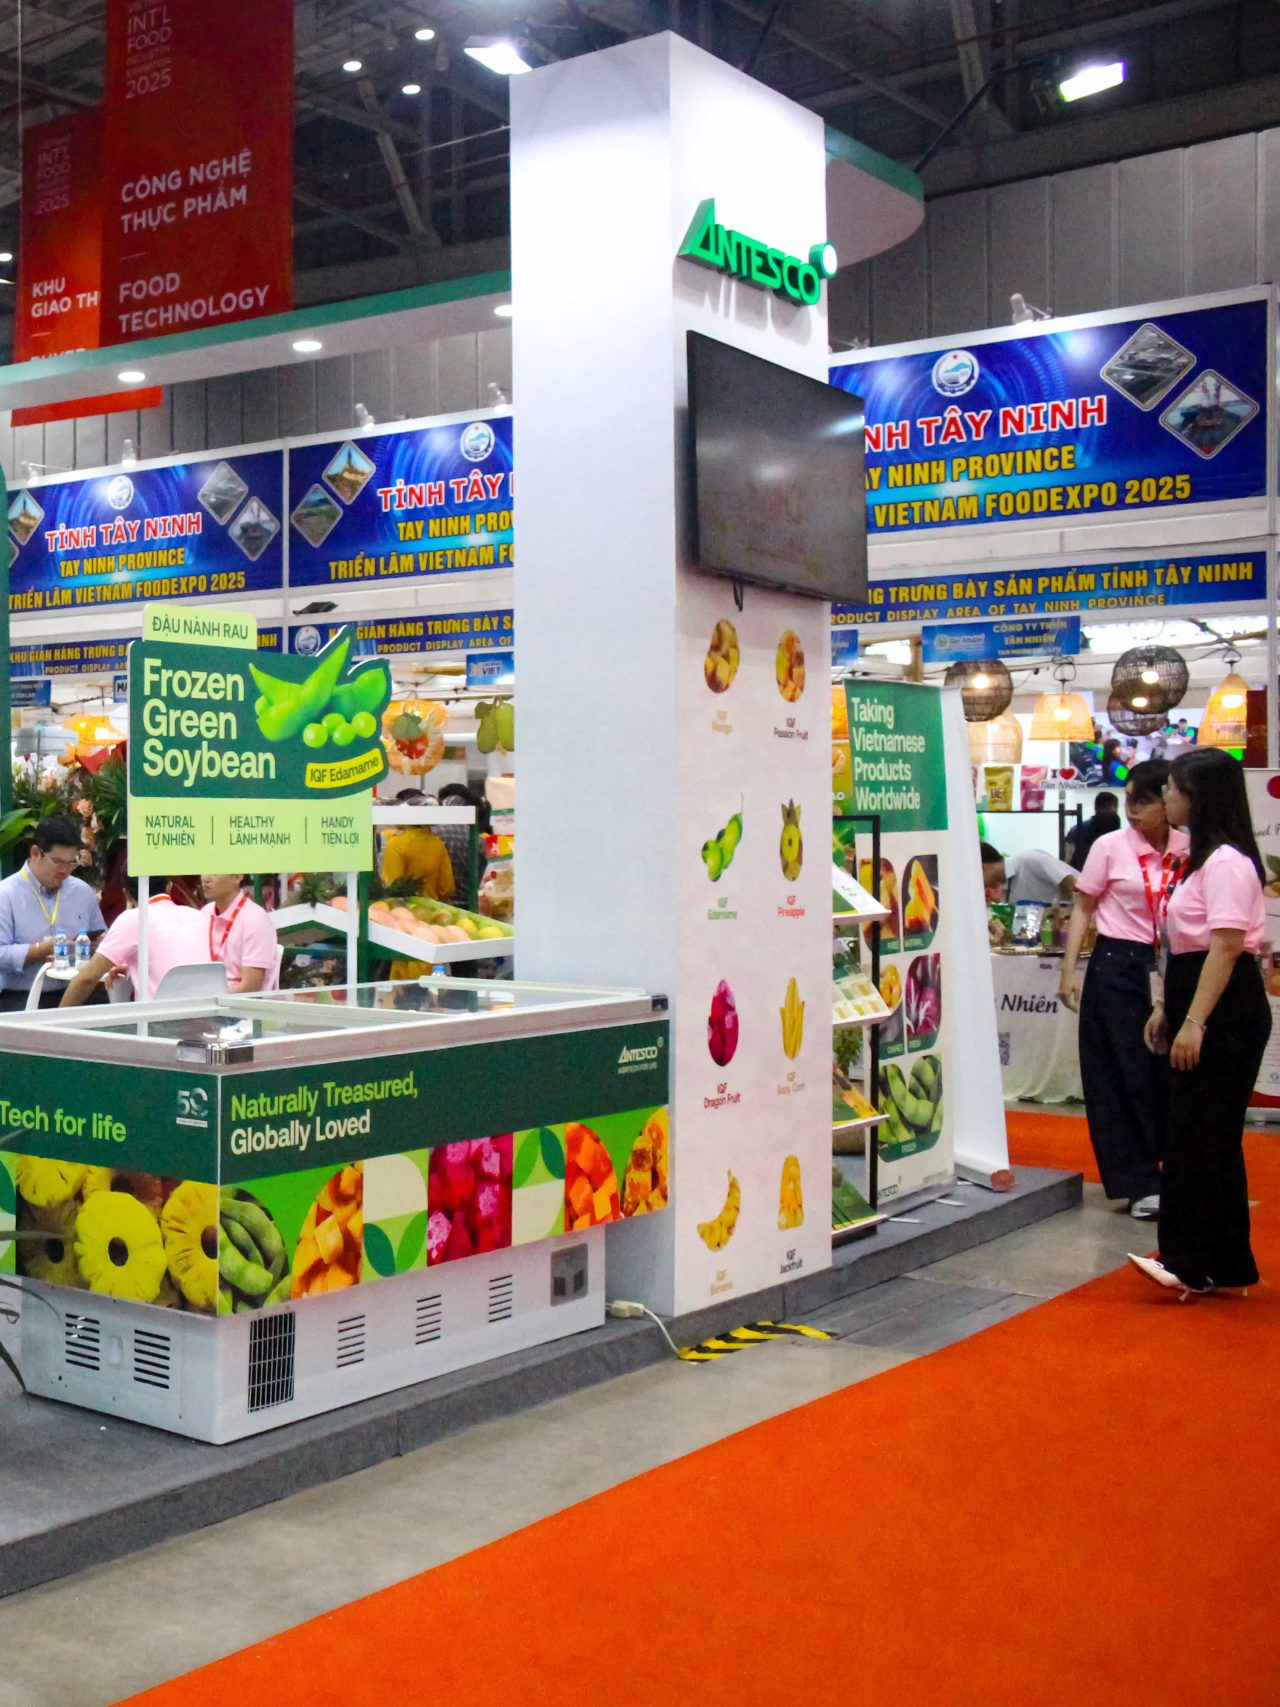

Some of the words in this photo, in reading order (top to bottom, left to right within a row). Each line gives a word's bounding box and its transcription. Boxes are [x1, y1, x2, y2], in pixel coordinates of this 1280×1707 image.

[128, 27, 172, 53] FOOD
[126, 68, 172, 99] 2025
[121, 169, 182, 203] CÔNG
[189, 147, 252, 187] NGHỆ
[121, 203, 177, 234] THỰC
[183, 180, 248, 218] PHẨM
[677, 198, 821, 307] ANTESCO
[32, 276, 66, 298] KHU
[120, 273, 181, 303] FOOD
[31, 297, 72, 318] GIAO
[119, 285, 271, 334] TECHNOLOGY
[917, 405, 992, 447] TÂY
[999, 395, 1108, 436] NINH
[887, 460, 946, 488] NINH
[951, 445, 1076, 482] PROVINCE
[378, 477, 445, 513] TỈNH
[451, 468, 504, 502] TÂY
[874, 494, 979, 528] VIETNAM
[985, 481, 1117, 518] FOODEXPO
[1124, 474, 1192, 504] 2025
[45, 523, 96, 552] TỈNH
[100, 517, 141, 545] TÂY
[144, 512, 203, 540] NINH
[397, 520, 424, 542] TAY
[428, 516, 470, 538] NINH
[60, 559, 80, 578] TAY
[83, 556, 115, 575] NINH
[119, 547, 185, 573] PROVINCE
[329, 551, 375, 579] TRIỂN
[418, 544, 495, 571] VIETNAM
[75, 582, 133, 604] VIETNAM
[136, 575, 208, 598] FOODEXPO
[210, 570, 246, 592] 2025
[888, 584, 948, 604] TRƯNG
[952, 577, 988, 599] BÀY
[993, 572, 1033, 597] SẢN
[1037, 565, 1095, 592] PHẨM
[1102, 564, 1149, 589] TỈNH
[1154, 562, 1193, 585] TÂY
[1198, 561, 1254, 584] NINH
[831, 612, 880, 625] RODUCT
[887, 608, 939, 621] DISPLAY
[947, 606, 980, 618] AREA
[988, 604, 1006, 616] OF
[1013, 602, 1036, 614] TAY
[1043, 600, 1081, 612] NINH
[1087, 593, 1166, 609] PROVINCE
[152, 613, 181, 638] ĐẬU
[223, 623, 249, 640] RAU
[257, 633, 277, 647] INH
[356, 622, 386, 640] GIAN
[389, 618, 424, 637] HÀNG
[427, 615, 470, 635] TRƯNG
[473, 612, 498, 631] BÀY
[29, 649, 52, 662] GIAN
[377, 641, 421, 654] PRODUCT
[425, 638, 464, 650] DISPLAY
[469, 636, 494, 647] AREA
[45, 665, 78, 675] PRODUCT
[82, 663, 111, 673] DISPLAY
[143, 657, 245, 702] Frozen
[142, 698, 237, 740] Green
[851, 697, 894, 729] Taking
[852, 727, 925, 753] Vietnamese
[142, 738, 276, 788] Soybean
[310, 767, 327, 784] IQF
[330, 757, 379, 782] Edamame
[854, 757, 911, 781] Products
[855, 786, 920, 811] Worldwide
[145, 815, 195, 829] NATURAL
[229, 815, 275, 829] HEALTHY
[321, 816, 354, 828] HANDY
[145, 832, 160, 849] TỰ
[162, 830, 195, 845] NHIÊN
[260, 832, 291, 848] MẠNH
[1001, 993, 1058, 1014] Nhiên
[618, 1044, 658, 1063] ANTESCO
[230, 1083, 319, 1122] Naturally
[323, 1070, 419, 1111] Treasured,
[703, 1096, 726, 1110] Dragon
[727, 1092, 741, 1104] Fruit
[53, 1107, 87, 1137] for
[91, 1112, 127, 1143] life
[230, 1116, 311, 1157] Globally
[314, 1109, 372, 1144] Loved
[779, 1257, 803, 1275] Jackfruit
